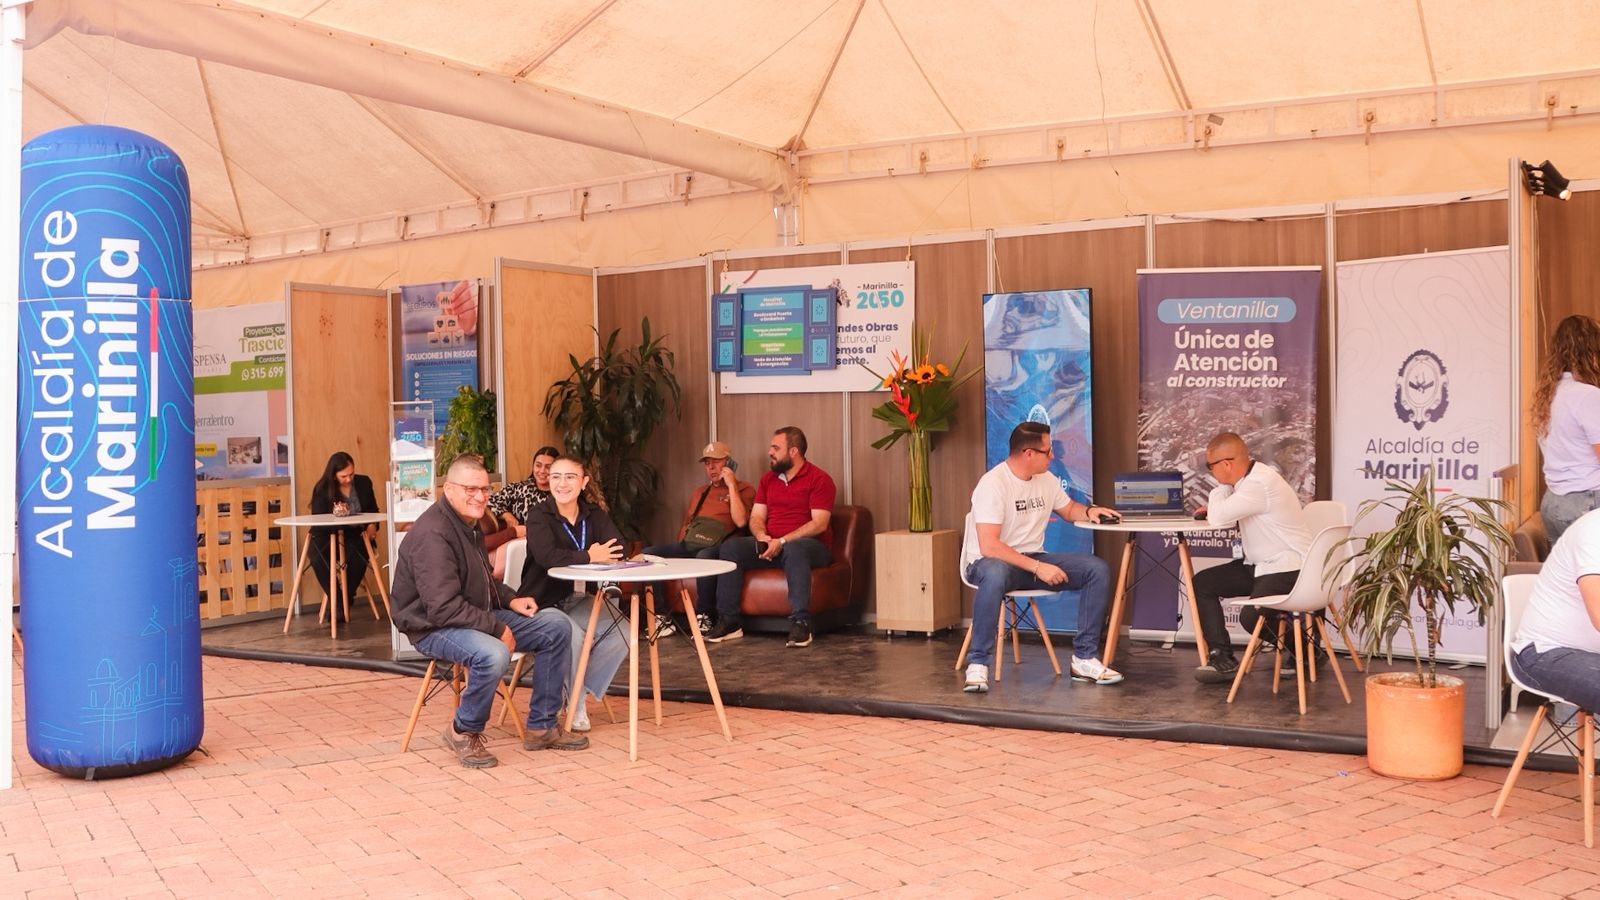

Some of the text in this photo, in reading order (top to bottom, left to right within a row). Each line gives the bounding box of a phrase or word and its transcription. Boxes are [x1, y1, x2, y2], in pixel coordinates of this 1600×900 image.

[863, 282, 898, 291] Marinilla
[1177, 300, 1279, 319] Ventanilla
[245, 326, 273, 337] Proyectos
[865, 322, 899, 332] Obras
[871, 335, 892, 345] que
[1174, 325, 1275, 349] Única de
[865, 344, 876, 354] al
[1173, 351, 1278, 372] Atención
[250, 366, 284, 380] 315 699
[33, 210, 77, 558] Alcaldía de
[82, 238, 139, 530] Marinilla
[1167, 374, 1287, 388] al constructor
[1366, 436, 1480, 454] Alcaldía de
[1364, 457, 1479, 480] Marinilla
[1213, 529, 1227, 537] de
[1163, 537, 1170, 548] y
[1171, 537, 1224, 547] Dsarrollo
